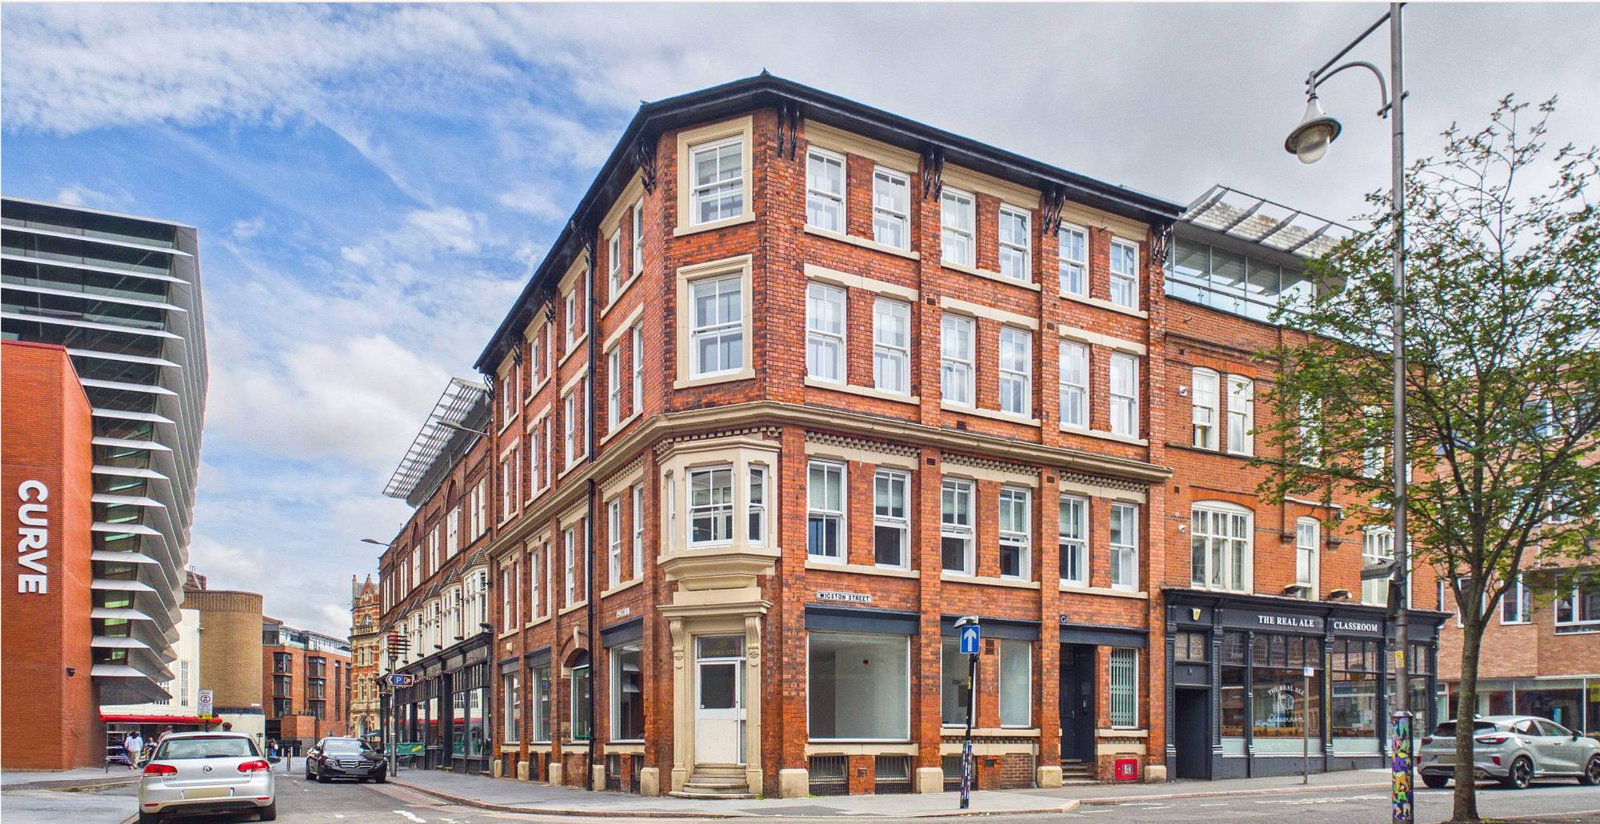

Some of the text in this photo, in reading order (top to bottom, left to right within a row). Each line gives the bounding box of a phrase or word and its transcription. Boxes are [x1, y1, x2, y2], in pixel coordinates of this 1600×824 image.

[18, 479, 48, 594] CURVE
[848, 594, 870, 602] STREET
[1258, 615, 1315, 628] THE REAL ALE
[1333, 621, 1378, 632] CLASSROOM
[1267, 686, 1279, 695] THE
[1294, 687, 1304, 696] ALE
